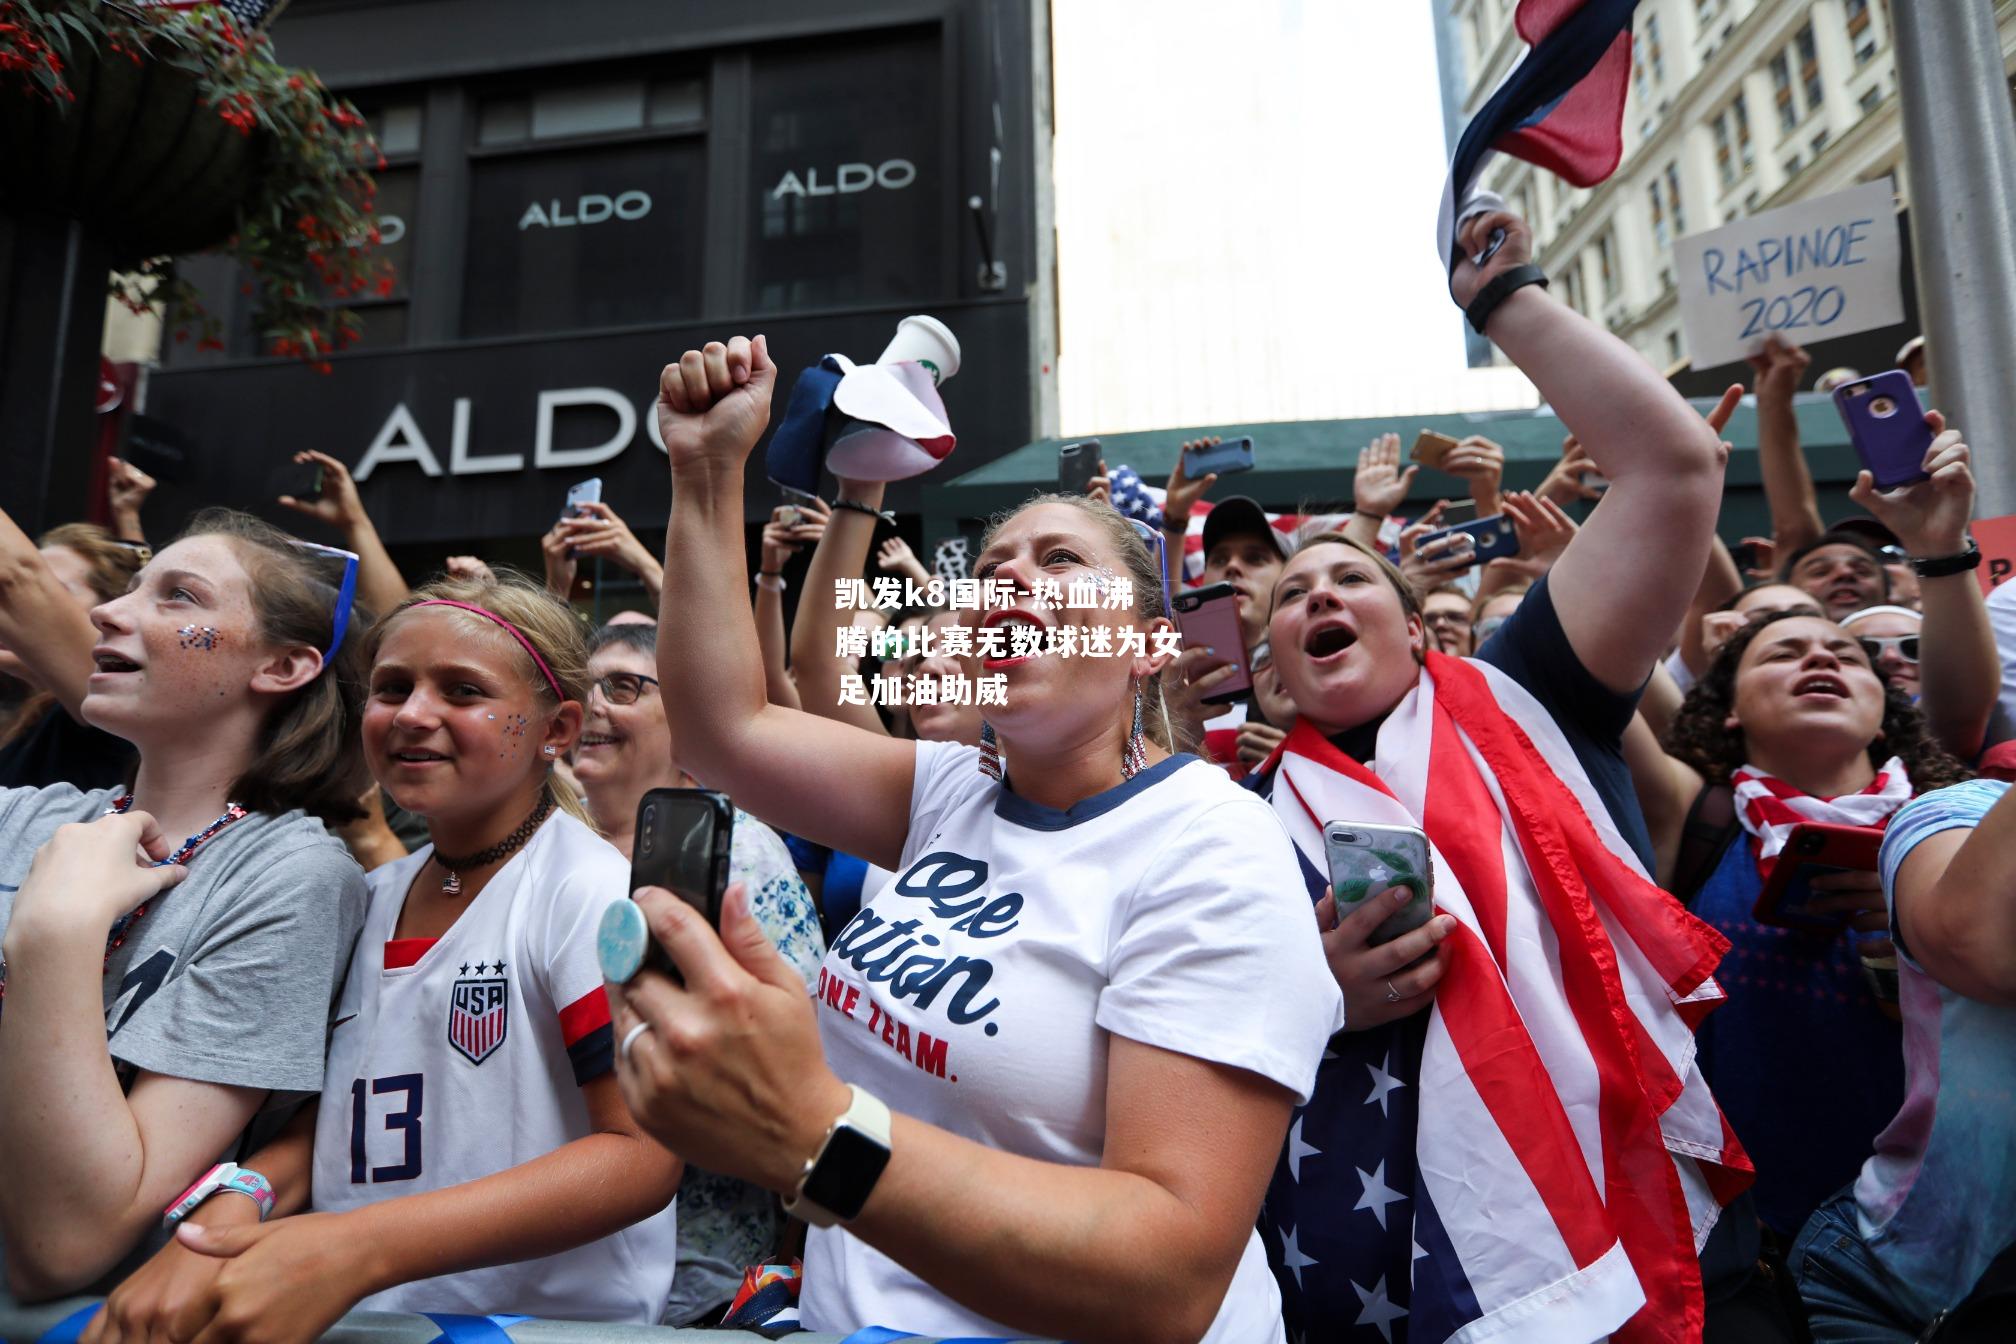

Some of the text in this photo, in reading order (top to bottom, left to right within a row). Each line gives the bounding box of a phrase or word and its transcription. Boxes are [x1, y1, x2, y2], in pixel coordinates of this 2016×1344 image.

[518, 189, 653, 231] ALDO
[772, 158, 917, 200] ALDO
[1703, 218, 1875, 295] RAPINOE
[1738, 285, 1846, 341] 2020
[351, 386, 668, 482] ALD
[455, 986, 503, 1016] USA
[817, 966, 958, 1083] ONE TEAM.
[350, 1072, 424, 1184] 13
